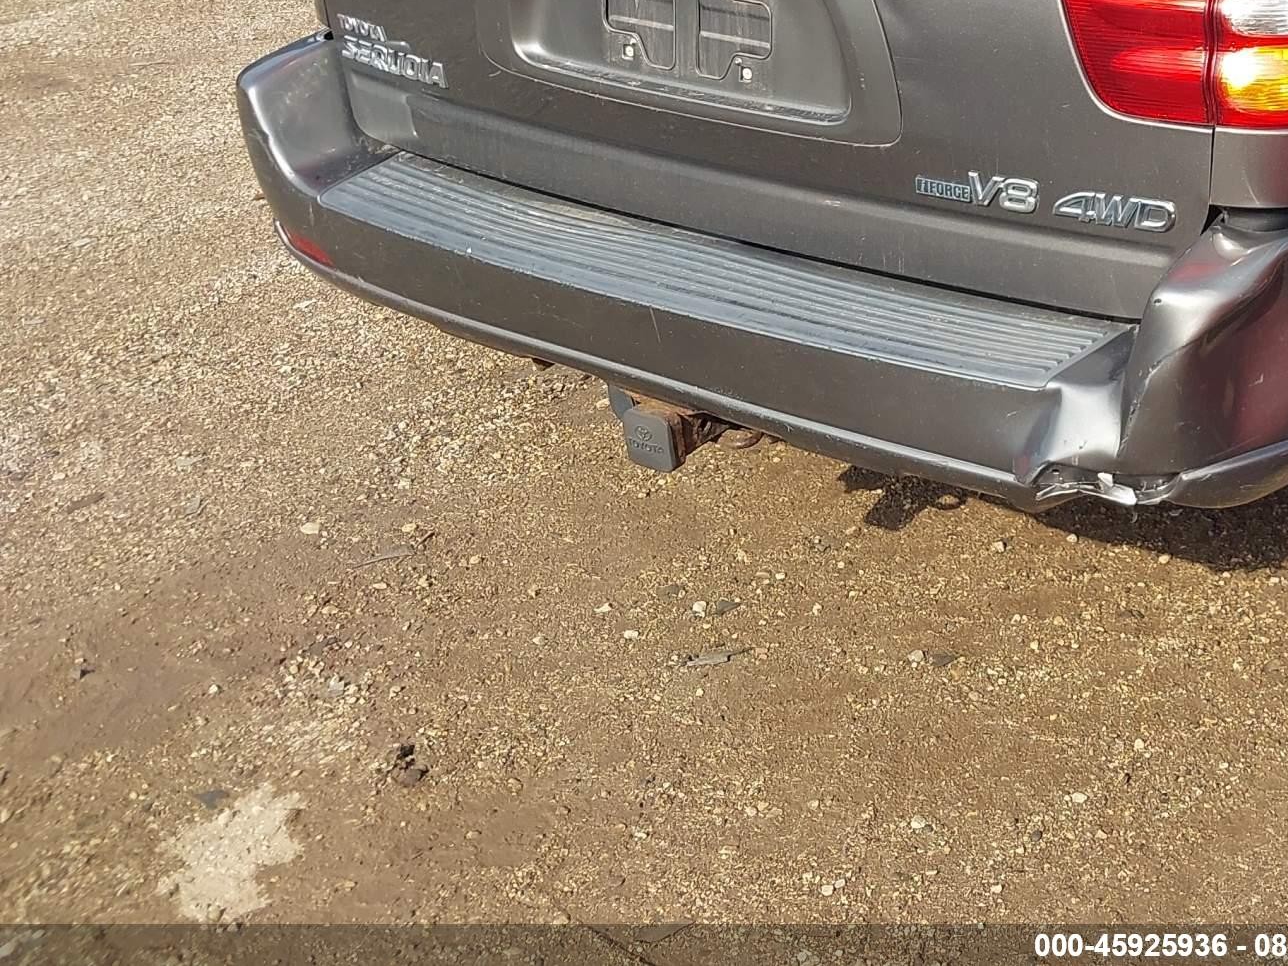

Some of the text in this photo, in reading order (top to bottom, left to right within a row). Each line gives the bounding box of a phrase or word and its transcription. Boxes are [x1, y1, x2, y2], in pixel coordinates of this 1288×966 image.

[336, 13, 387, 42] TOYOTA
[342, 35, 448, 89] SEQUOIA
[967, 170, 1040, 214] V8
[1052, 191, 1176, 233] 4WD
